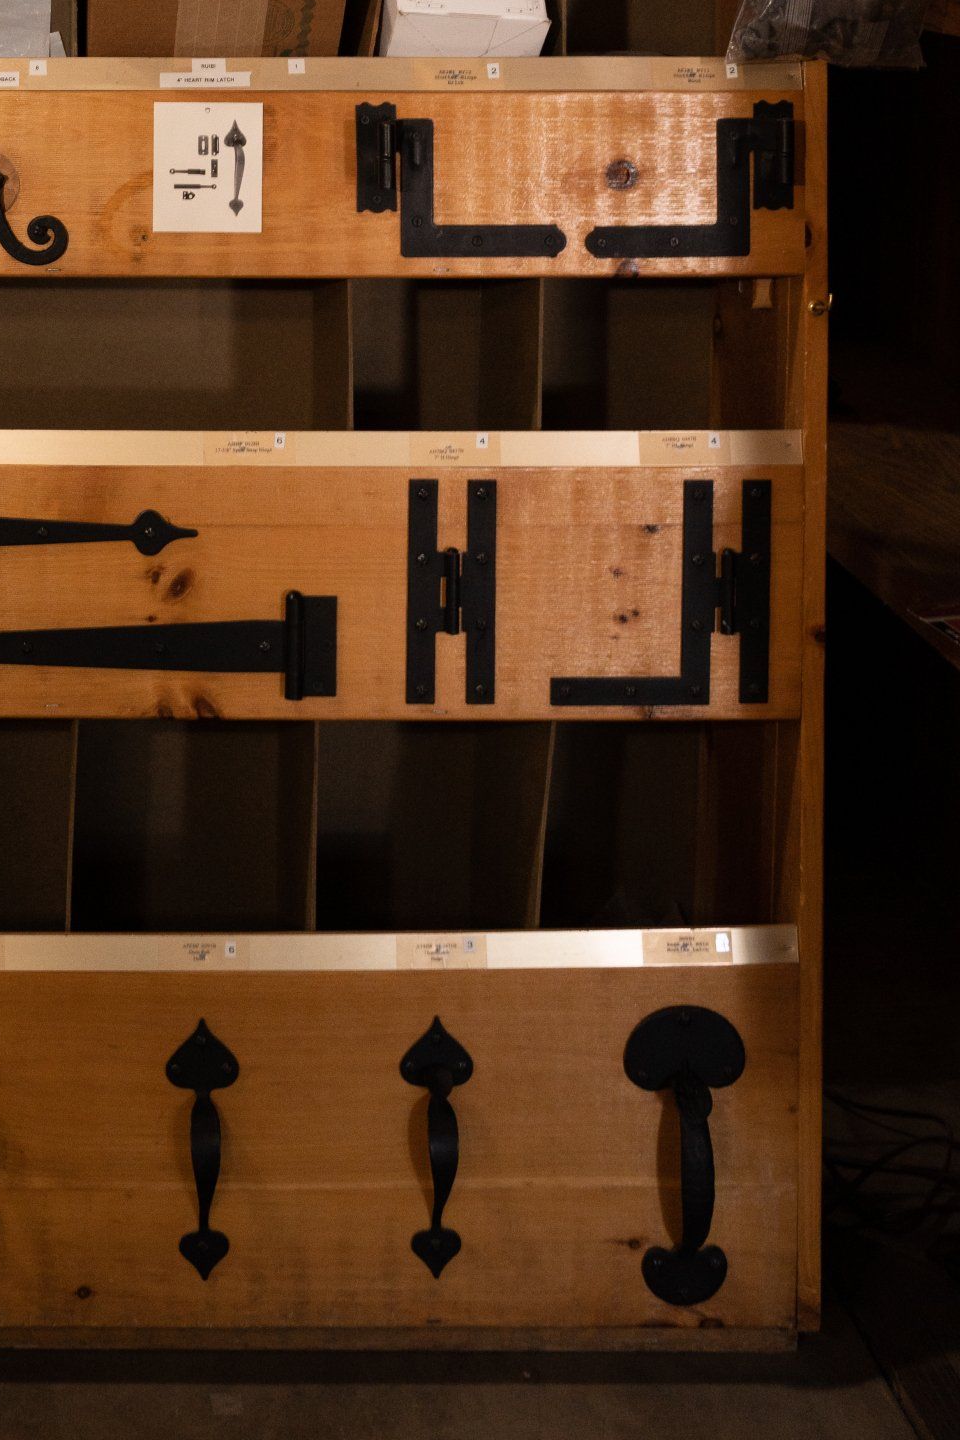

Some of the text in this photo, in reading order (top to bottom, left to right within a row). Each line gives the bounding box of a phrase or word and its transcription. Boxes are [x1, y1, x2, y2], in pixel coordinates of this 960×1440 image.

[491, 67, 497, 75] 2
[729, 67, 735, 75] 2
[277, 437, 283, 445] 6
[711, 437, 717, 445] 4
[228, 946, 235, 954] 6
